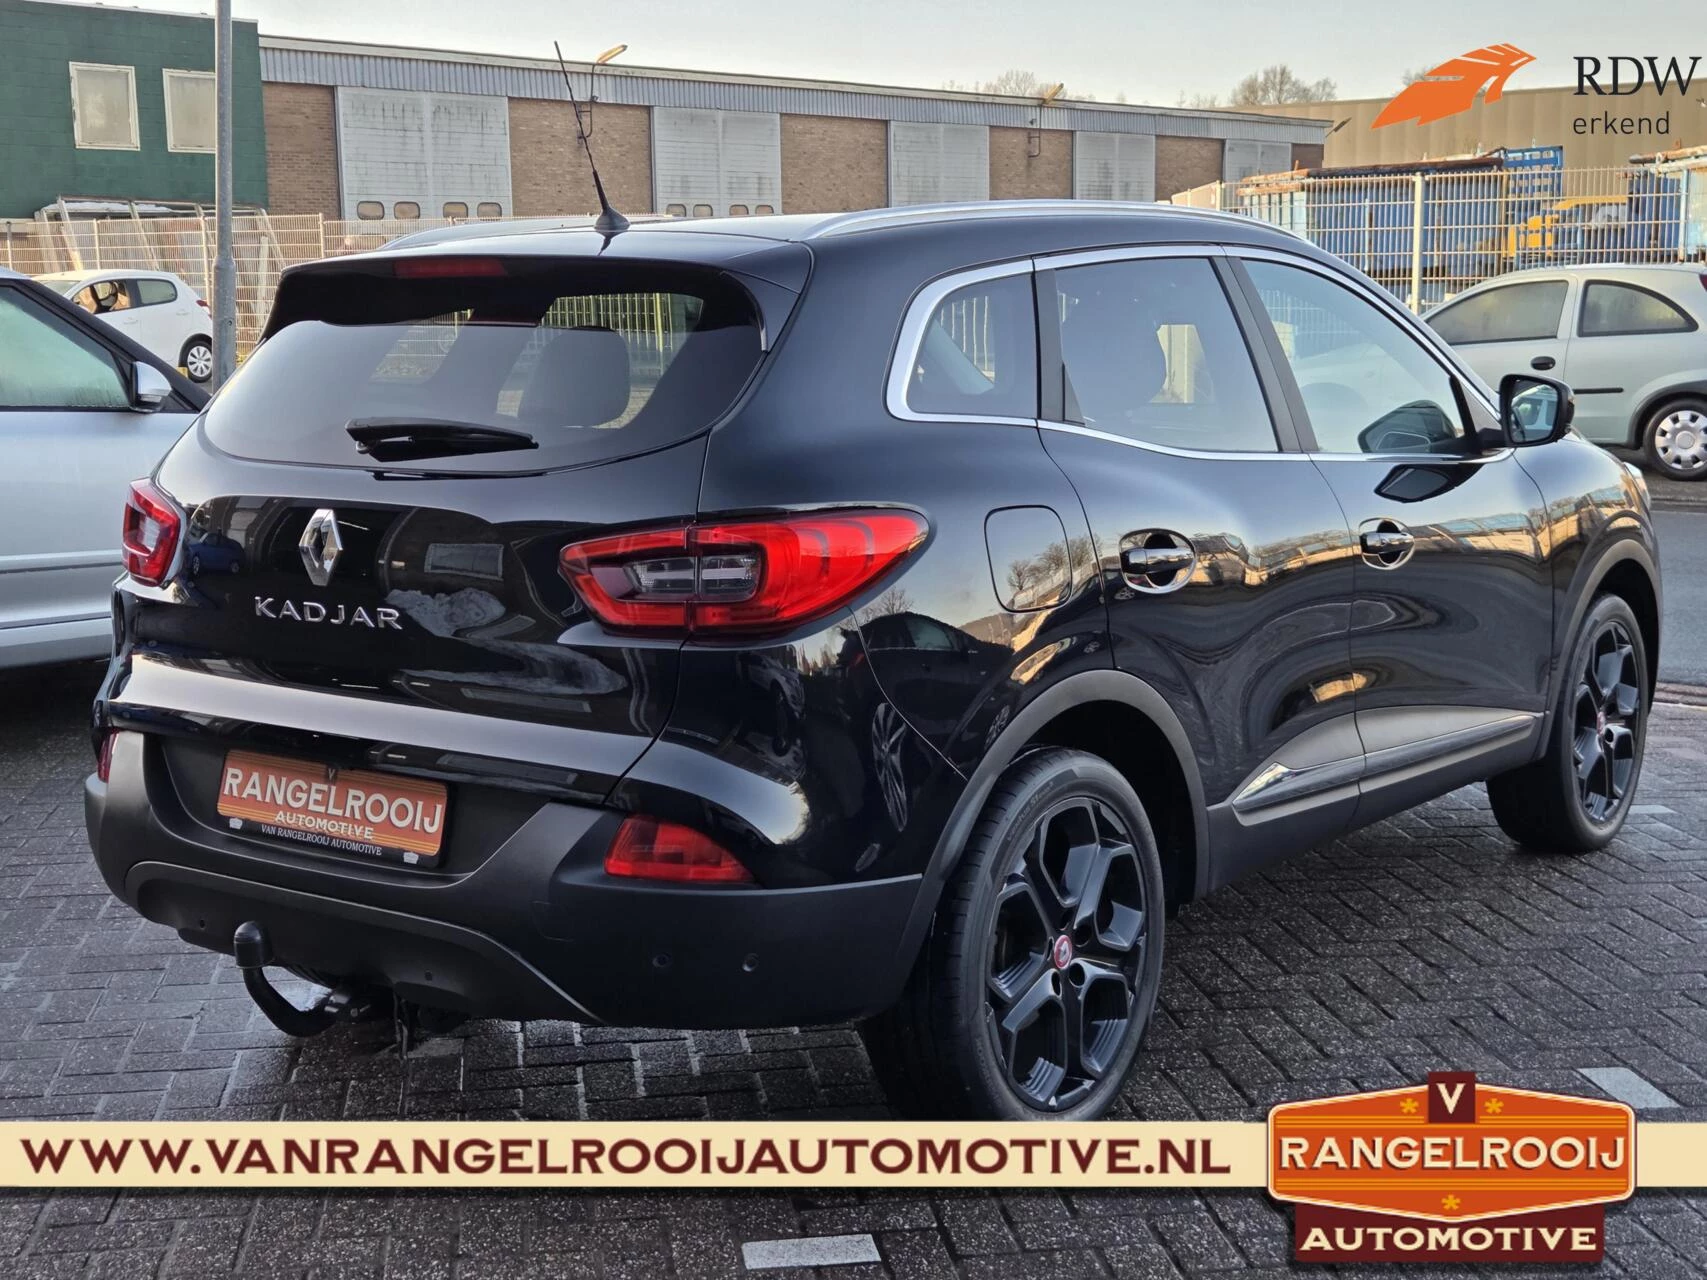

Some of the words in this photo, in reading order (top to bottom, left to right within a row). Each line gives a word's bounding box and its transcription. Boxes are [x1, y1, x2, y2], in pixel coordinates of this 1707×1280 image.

[254, 596, 402, 630] KADJAR
[223, 767, 443, 834] RANGELROOIJ
[261, 824, 276, 835] VAN
[277, 826, 330, 846] RANGELROOIJ
[330, 839, 383, 856] AUTOMOTIVE
[274, 810, 375, 840] AUTOMOTIVE
